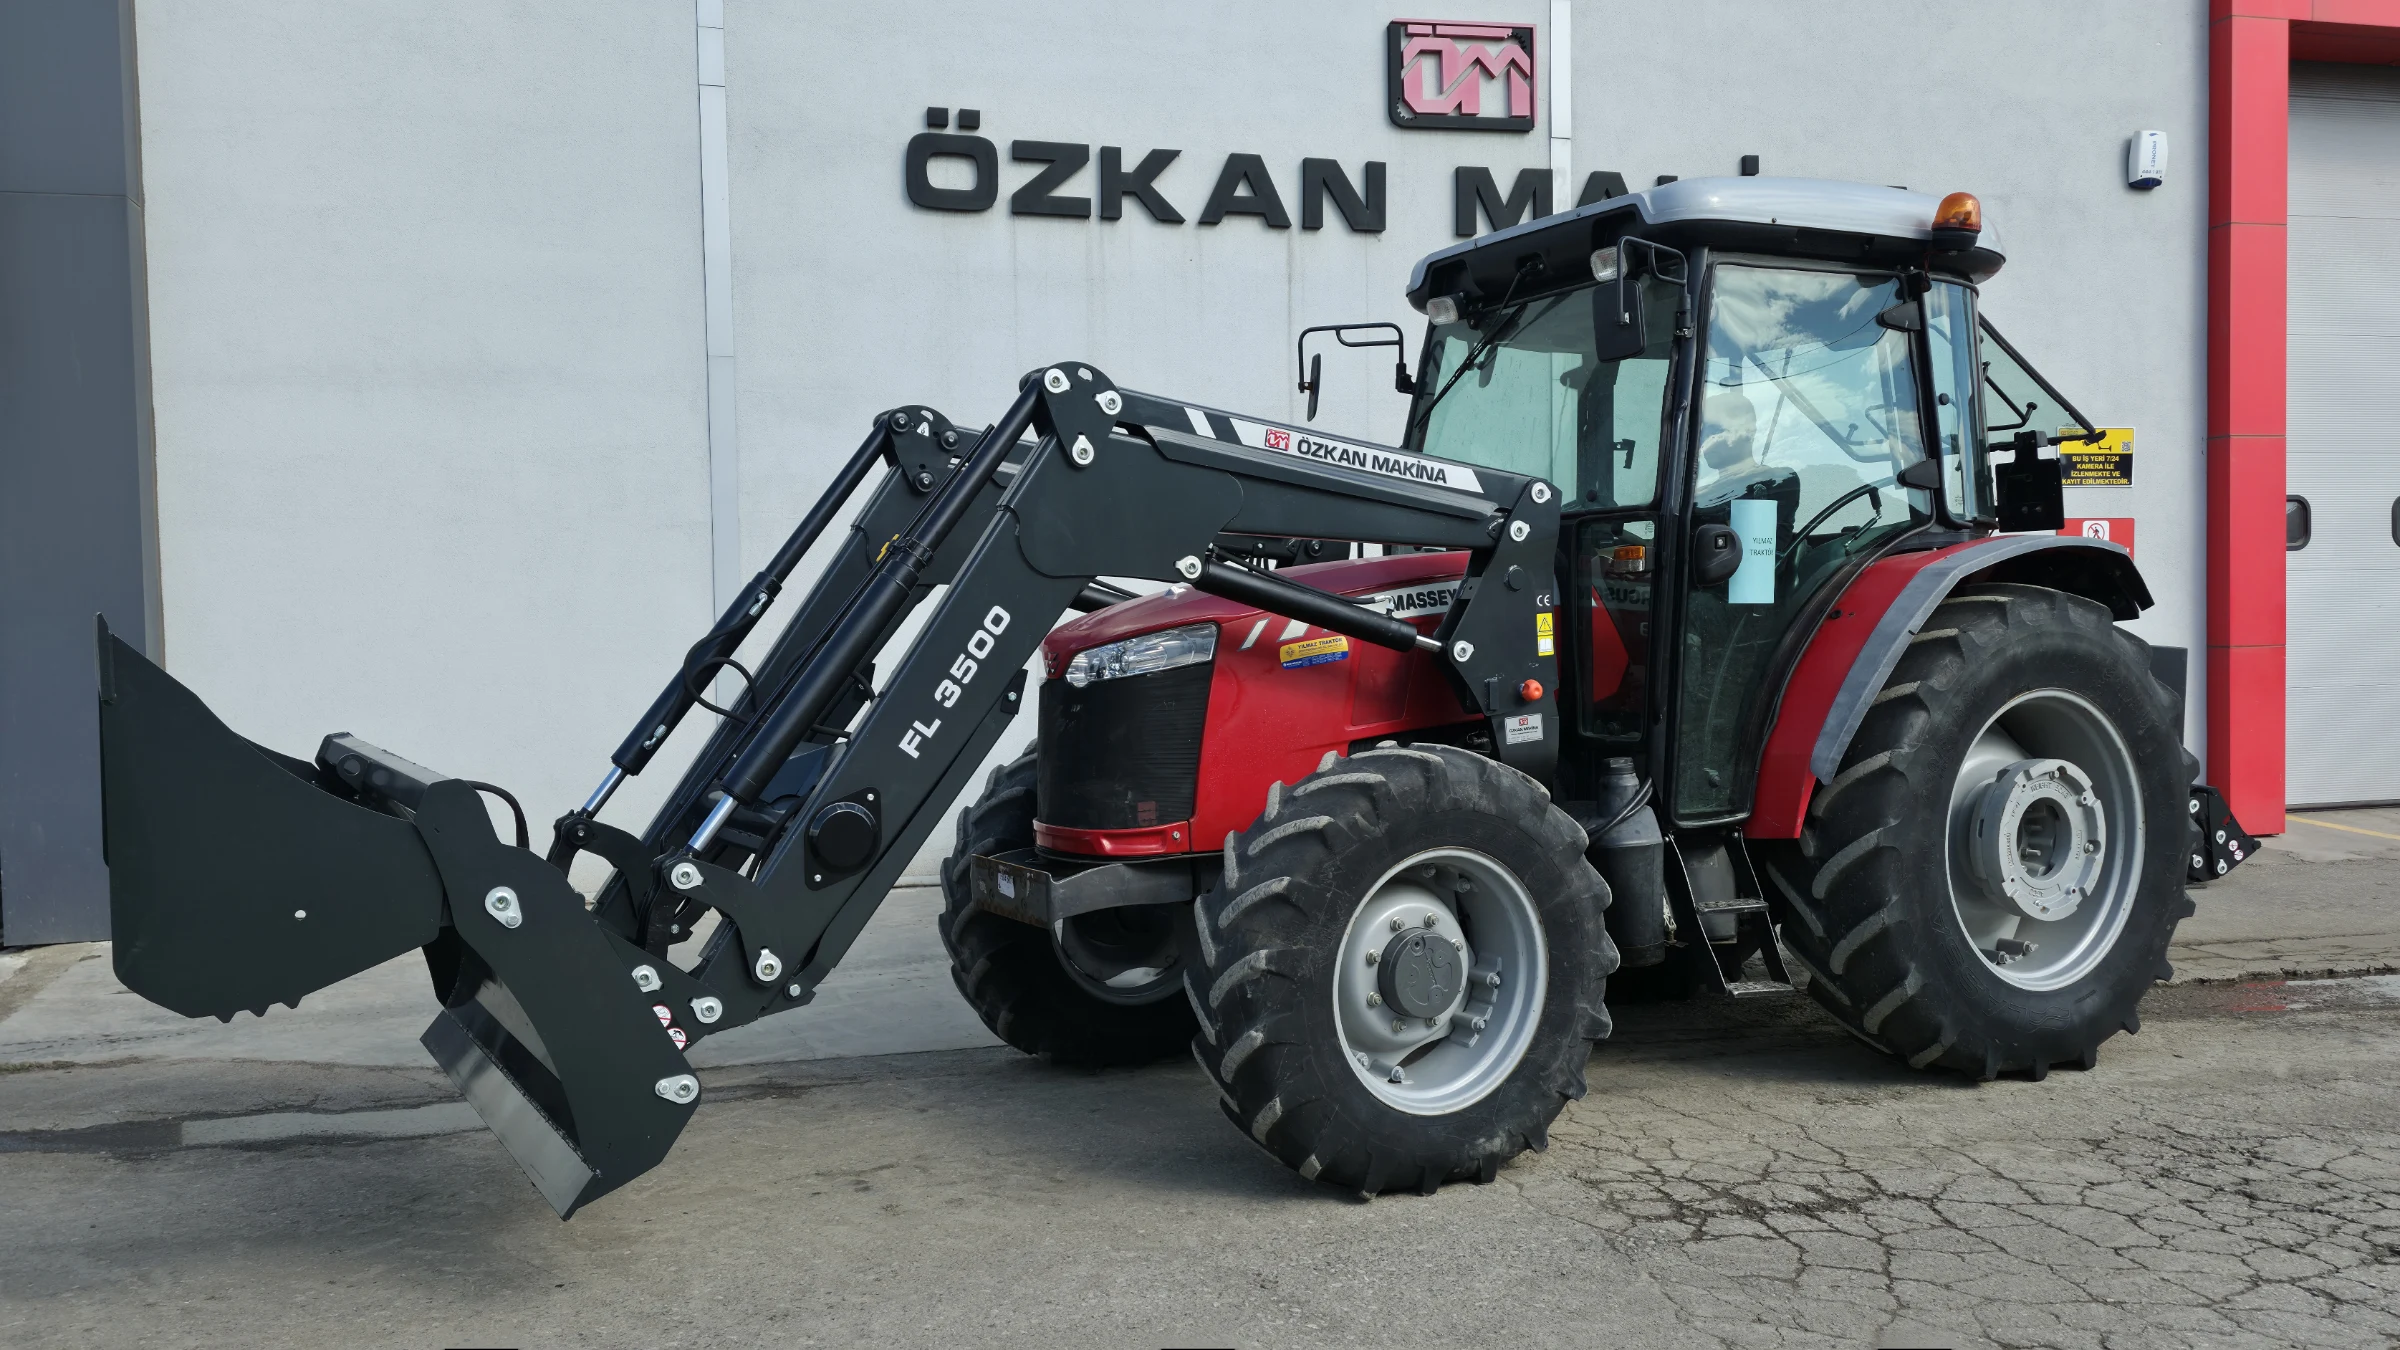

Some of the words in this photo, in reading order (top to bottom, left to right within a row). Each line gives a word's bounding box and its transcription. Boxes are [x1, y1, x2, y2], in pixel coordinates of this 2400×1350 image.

[905, 107, 1387, 232] ÖZKAN
[1297, 436, 1368, 468] ÖZKAN
[1371, 455, 1448, 484] MAKİNA
[2083, 454, 2090, 462] İŞ
[2090, 454, 2105, 462] YERİ
[1392, 588, 1457, 612] MASSEY
[898, 718, 942, 759] FL
[934, 605, 1011, 708] 3500
